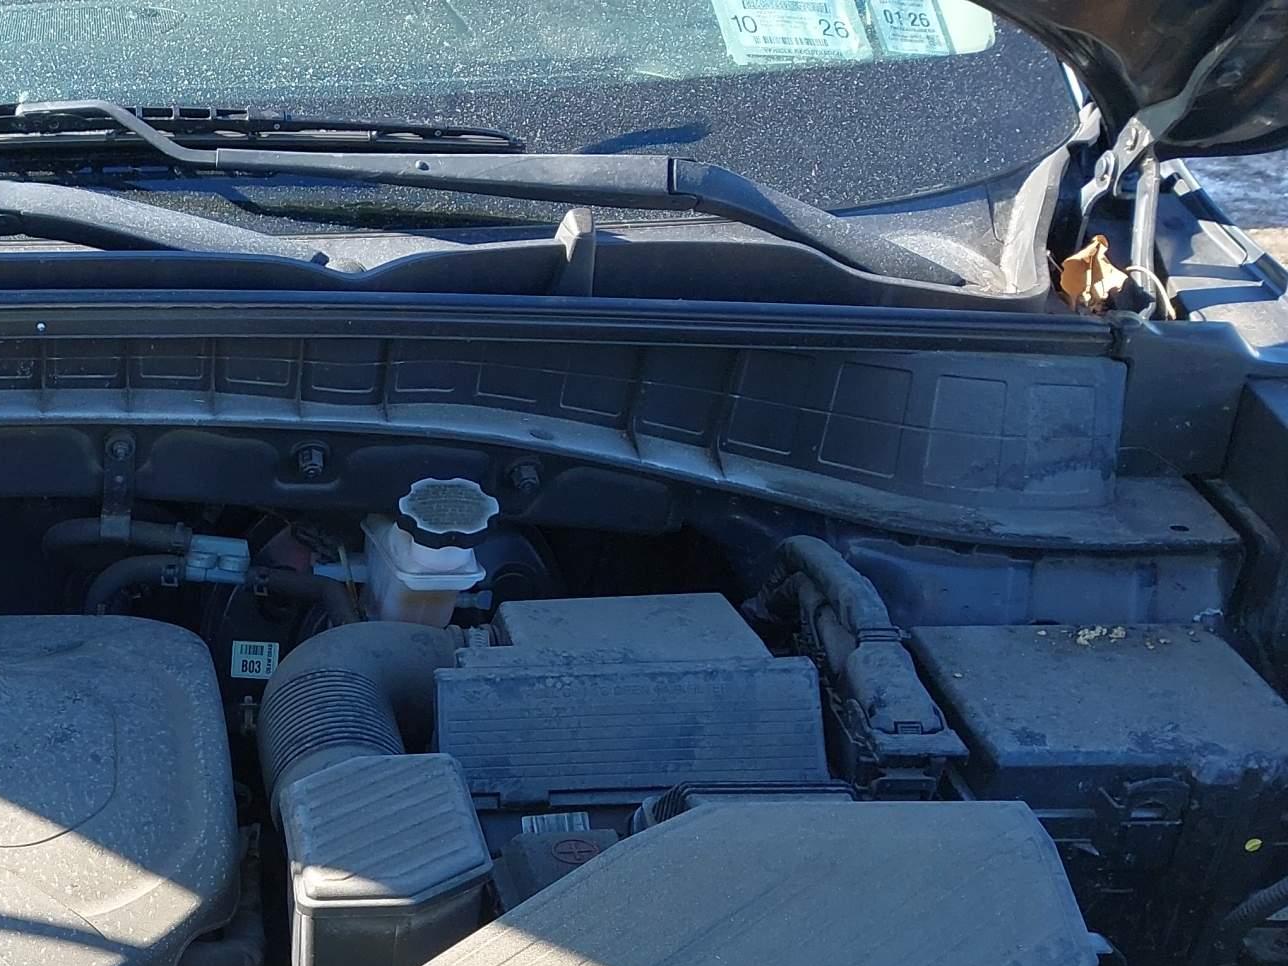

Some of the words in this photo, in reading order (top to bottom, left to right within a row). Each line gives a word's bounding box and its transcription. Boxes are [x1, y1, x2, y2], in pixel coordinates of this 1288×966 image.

[730, 14, 758, 34] 10
[818, 18, 850, 39] 26
[883, 9, 904, 26] 01
[907, 12, 930, 28] 26
[241, 658, 262, 674] B03
